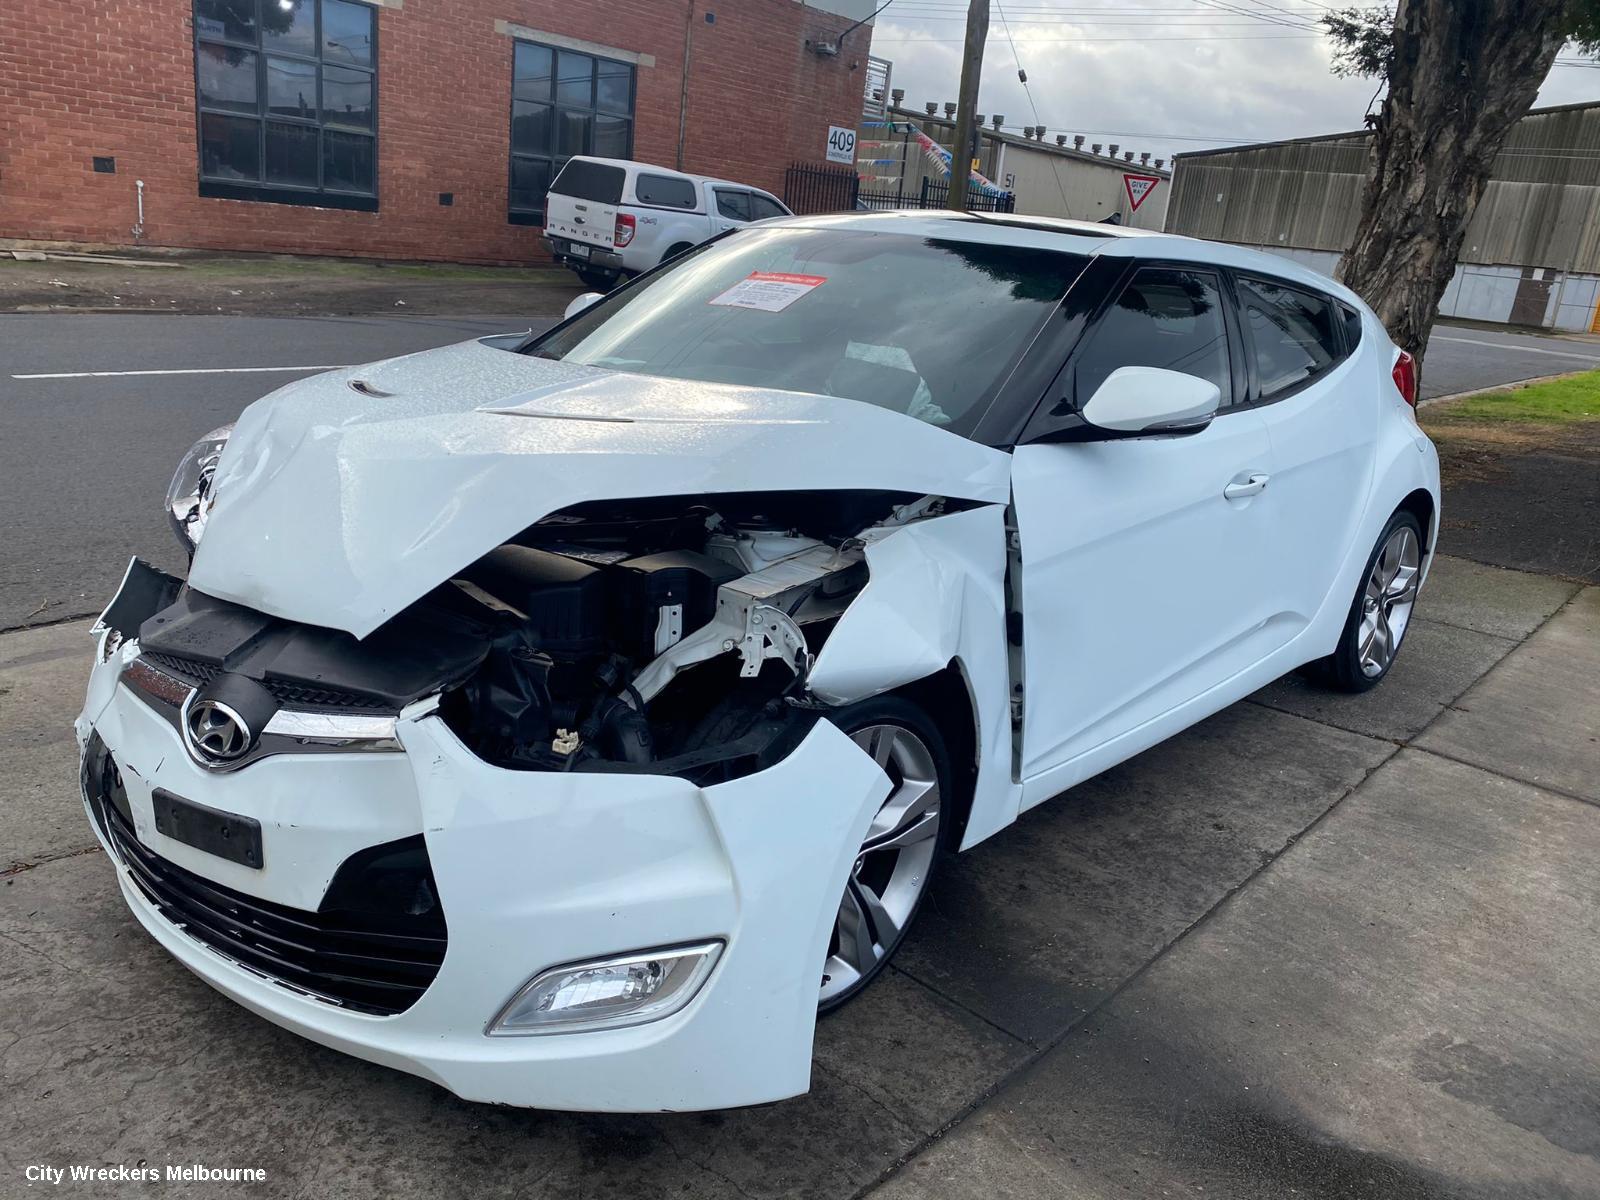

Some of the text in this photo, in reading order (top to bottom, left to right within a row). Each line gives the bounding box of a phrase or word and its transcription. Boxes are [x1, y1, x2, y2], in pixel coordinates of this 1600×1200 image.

[829, 130, 855, 152] 409
[1005, 173, 1015, 188] 51
[1132, 181, 1149, 189] GIVE
[549, 223, 612, 242] RANGER
